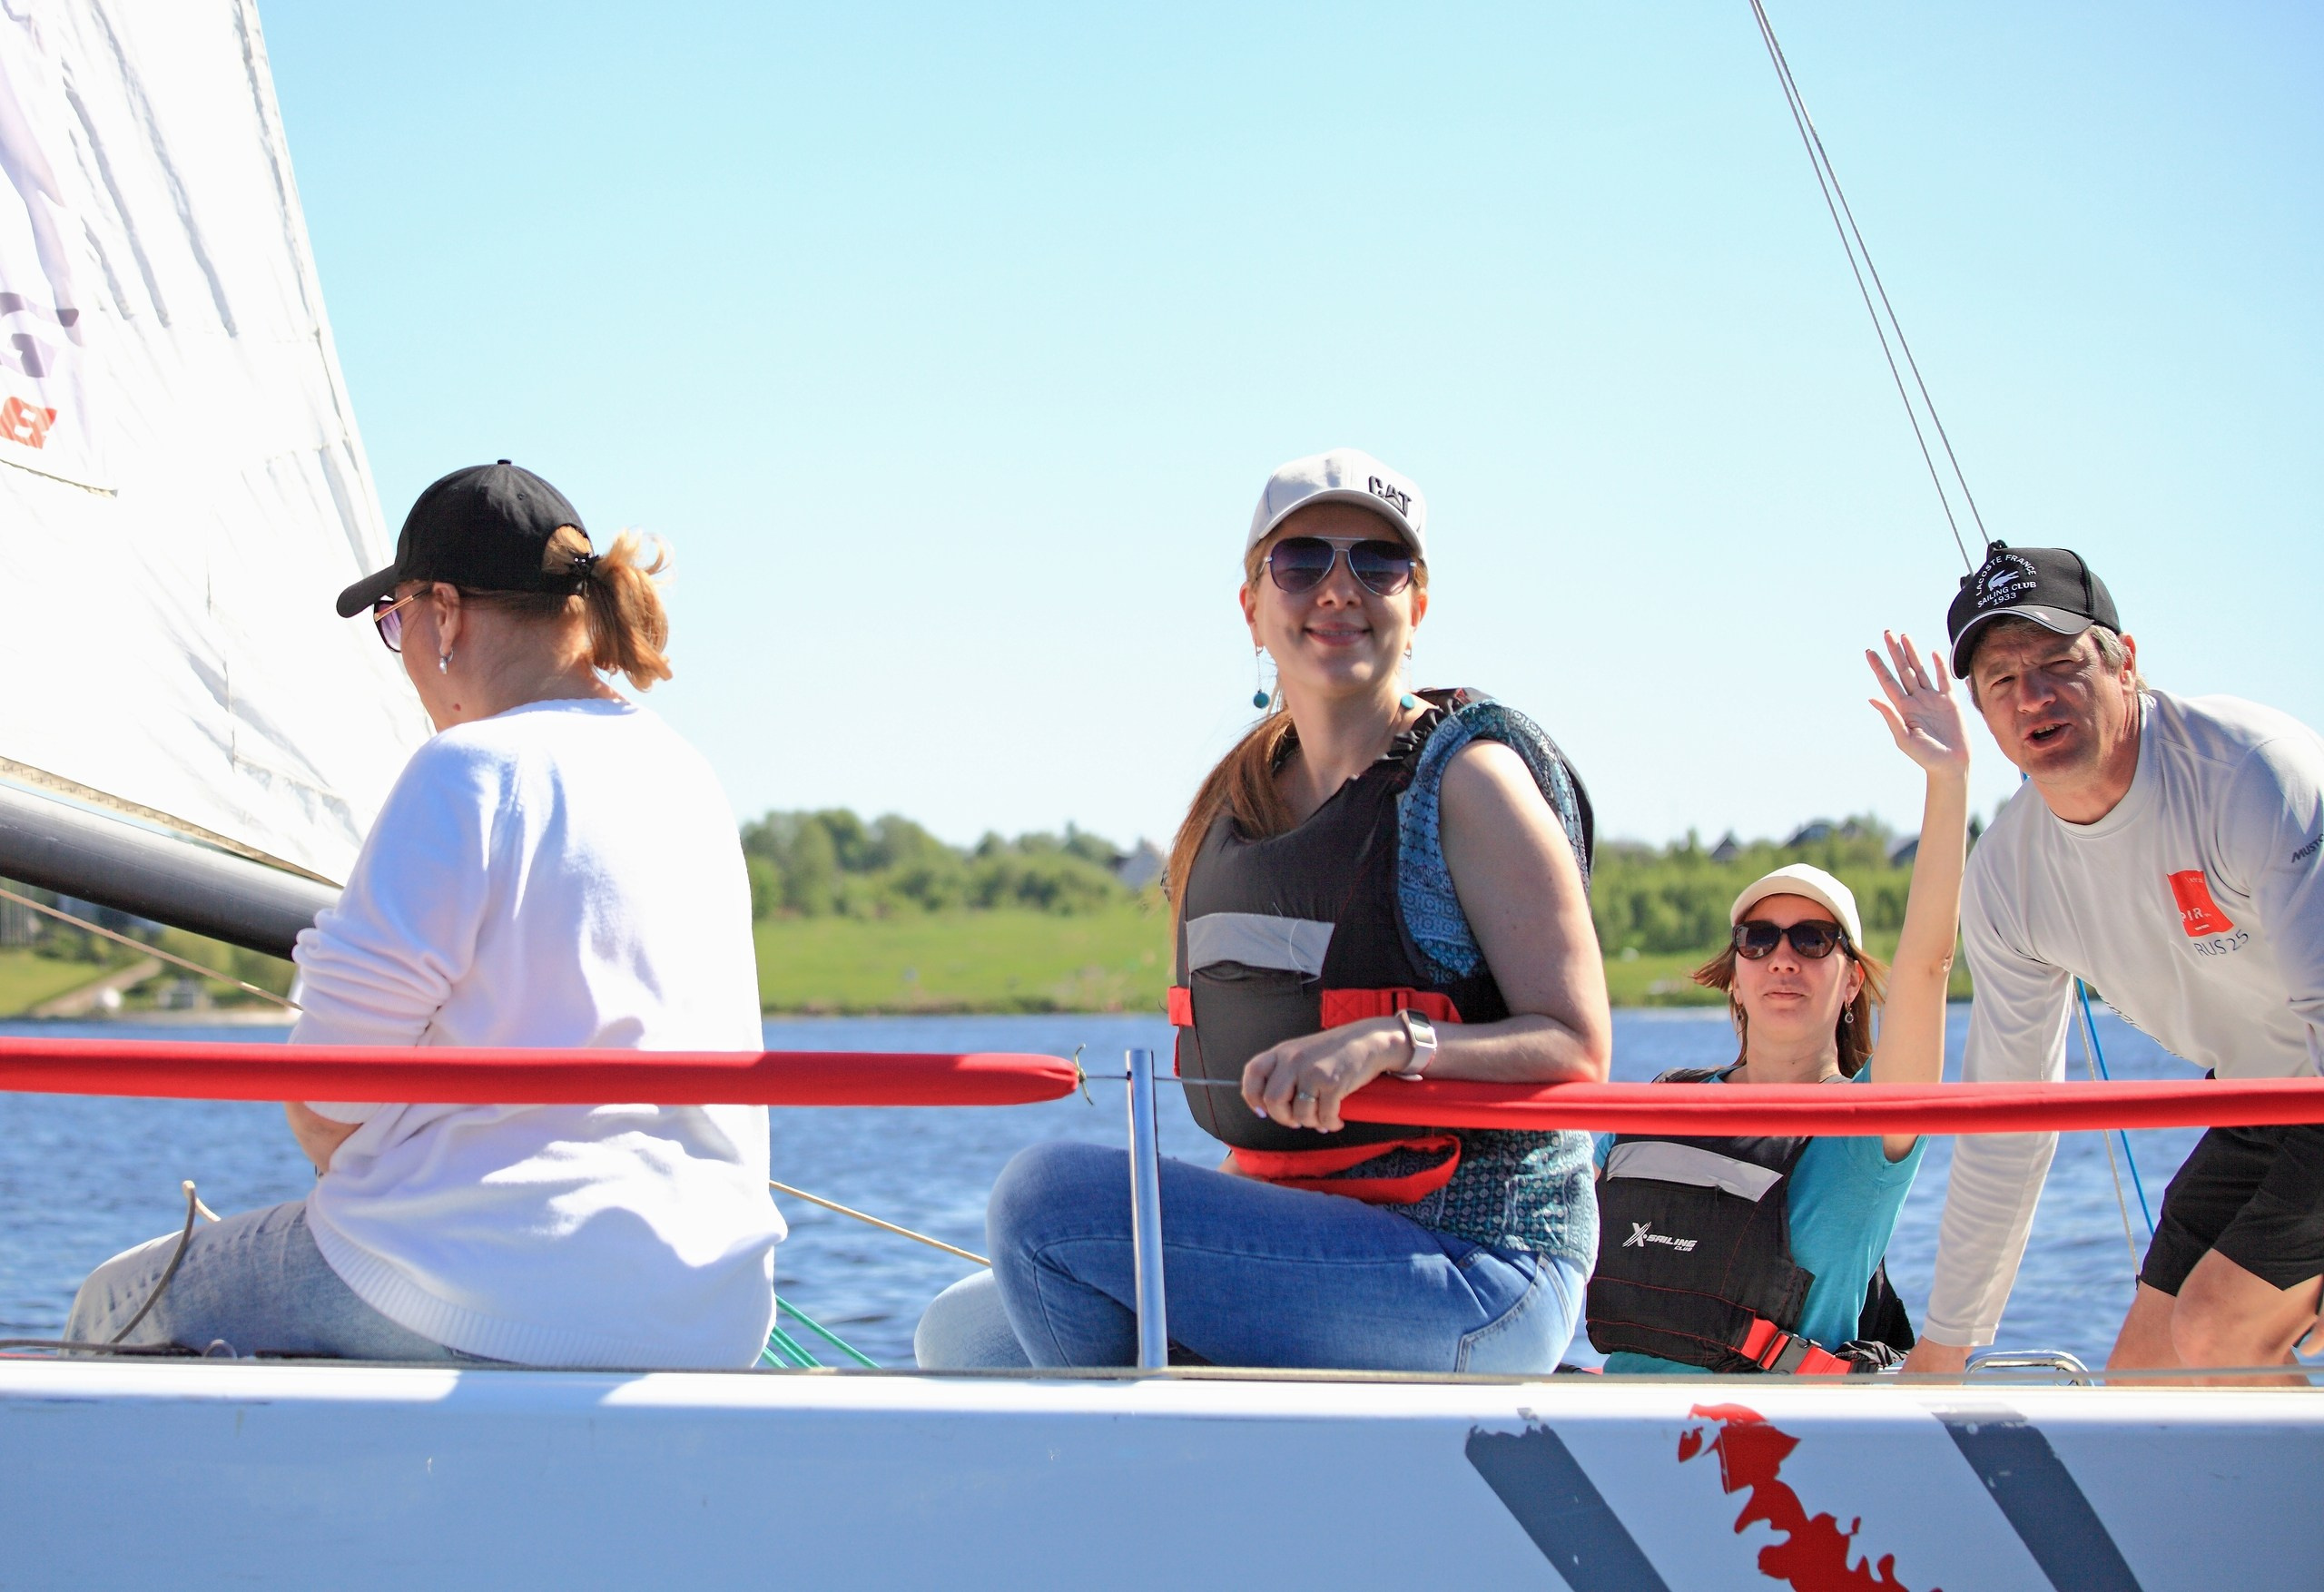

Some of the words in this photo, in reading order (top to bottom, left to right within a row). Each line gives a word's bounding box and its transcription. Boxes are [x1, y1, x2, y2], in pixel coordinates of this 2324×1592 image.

[1369, 476, 1412, 518] CAT
[1976, 555, 2002, 596] LACOSTE
[2005, 555, 2036, 575] FRANCE
[1977, 586, 2009, 608] SAILING
[2011, 581, 2036, 591] CLUB
[1994, 592, 2016, 605] 1933
[2193, 939, 2227, 957] RUS
[2226, 929, 2249, 951] 25
